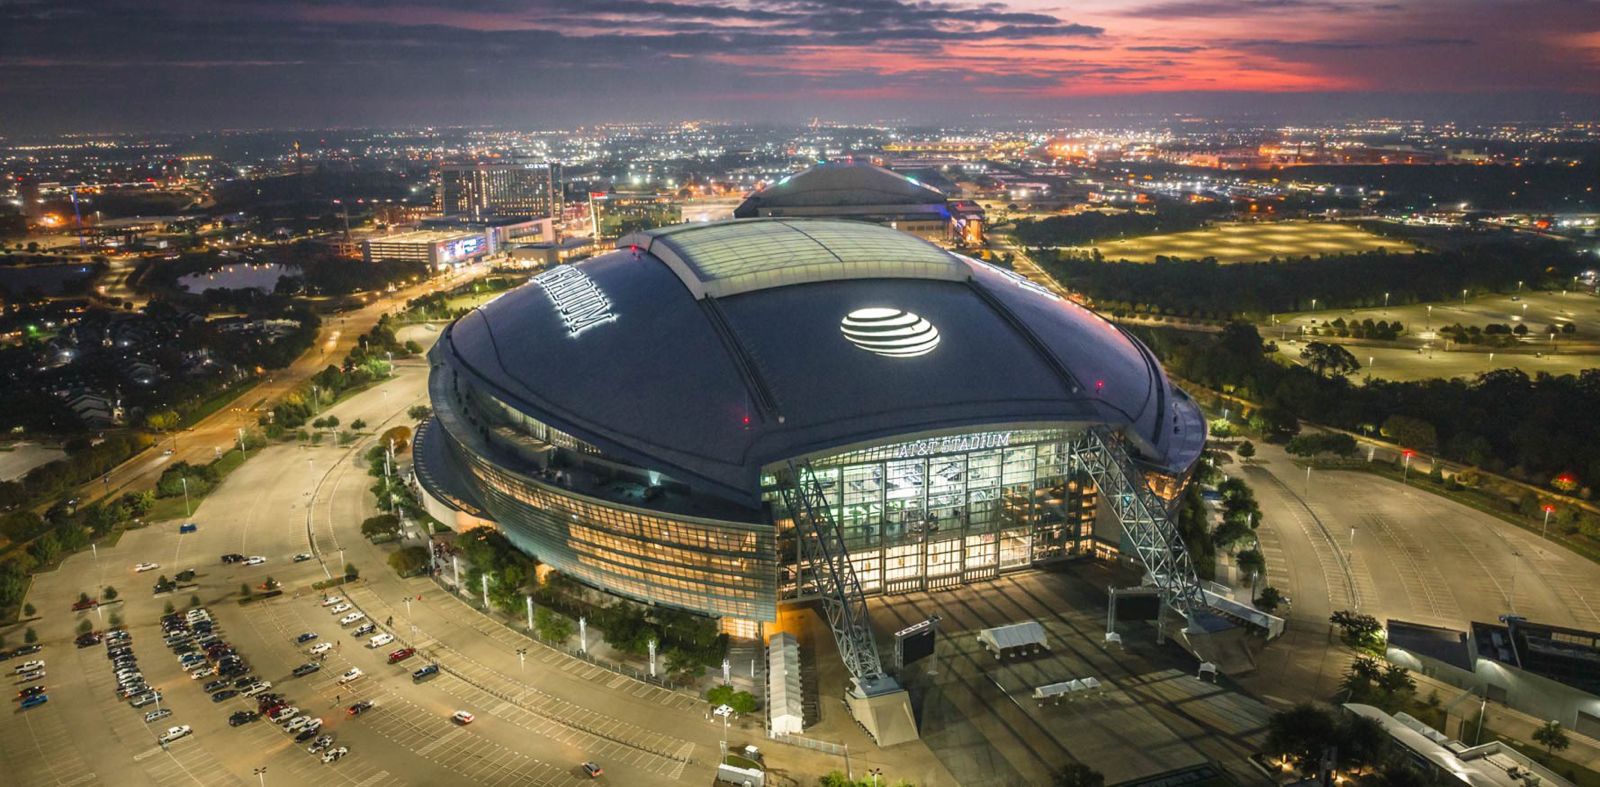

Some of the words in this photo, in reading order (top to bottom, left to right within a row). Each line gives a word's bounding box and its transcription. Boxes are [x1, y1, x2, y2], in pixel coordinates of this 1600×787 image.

[537, 266, 617, 336] STADIUM
[898, 441, 938, 458] AT&T
[941, 433, 1011, 453] STADIUM
